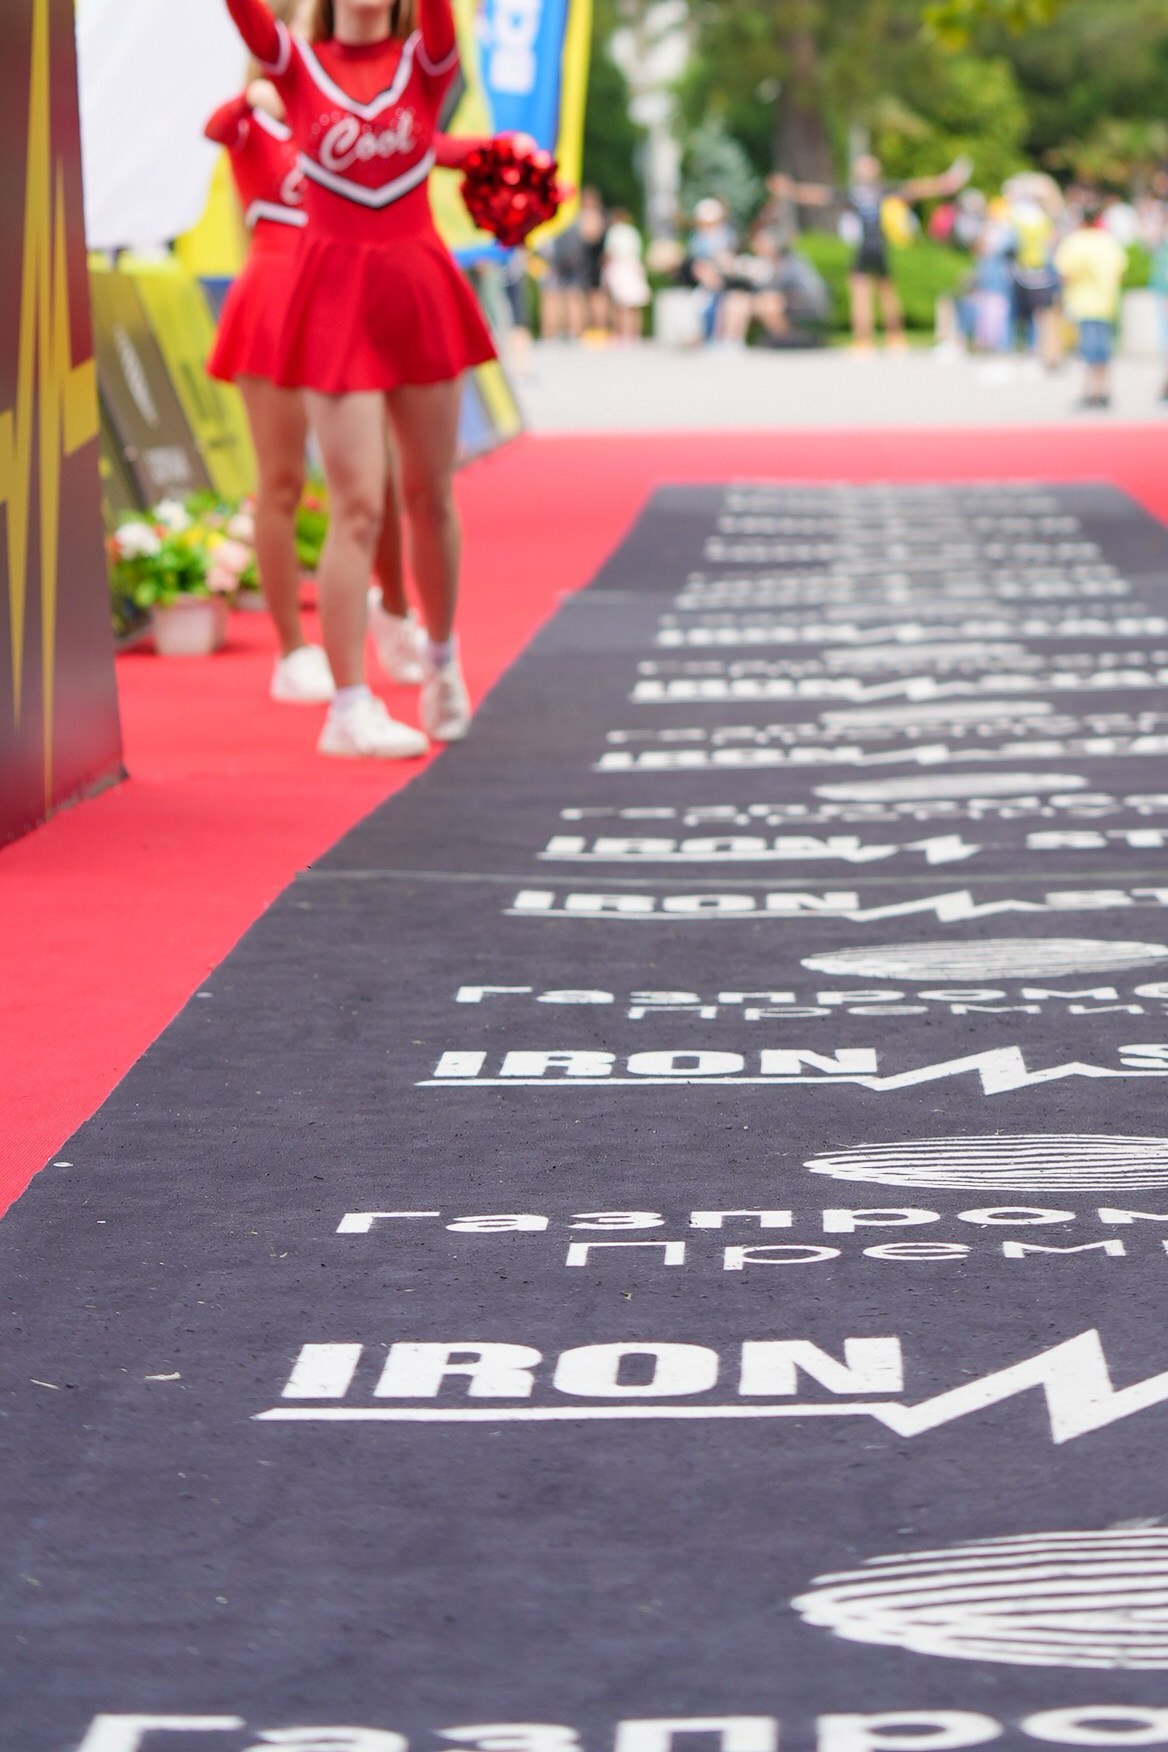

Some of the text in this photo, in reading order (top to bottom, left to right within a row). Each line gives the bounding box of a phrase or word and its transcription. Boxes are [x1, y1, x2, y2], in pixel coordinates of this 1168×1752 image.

[514, 889, 860, 913] IRON
[433, 1048, 878, 1077] IRON
[280, 1336, 905, 1398] IRON
